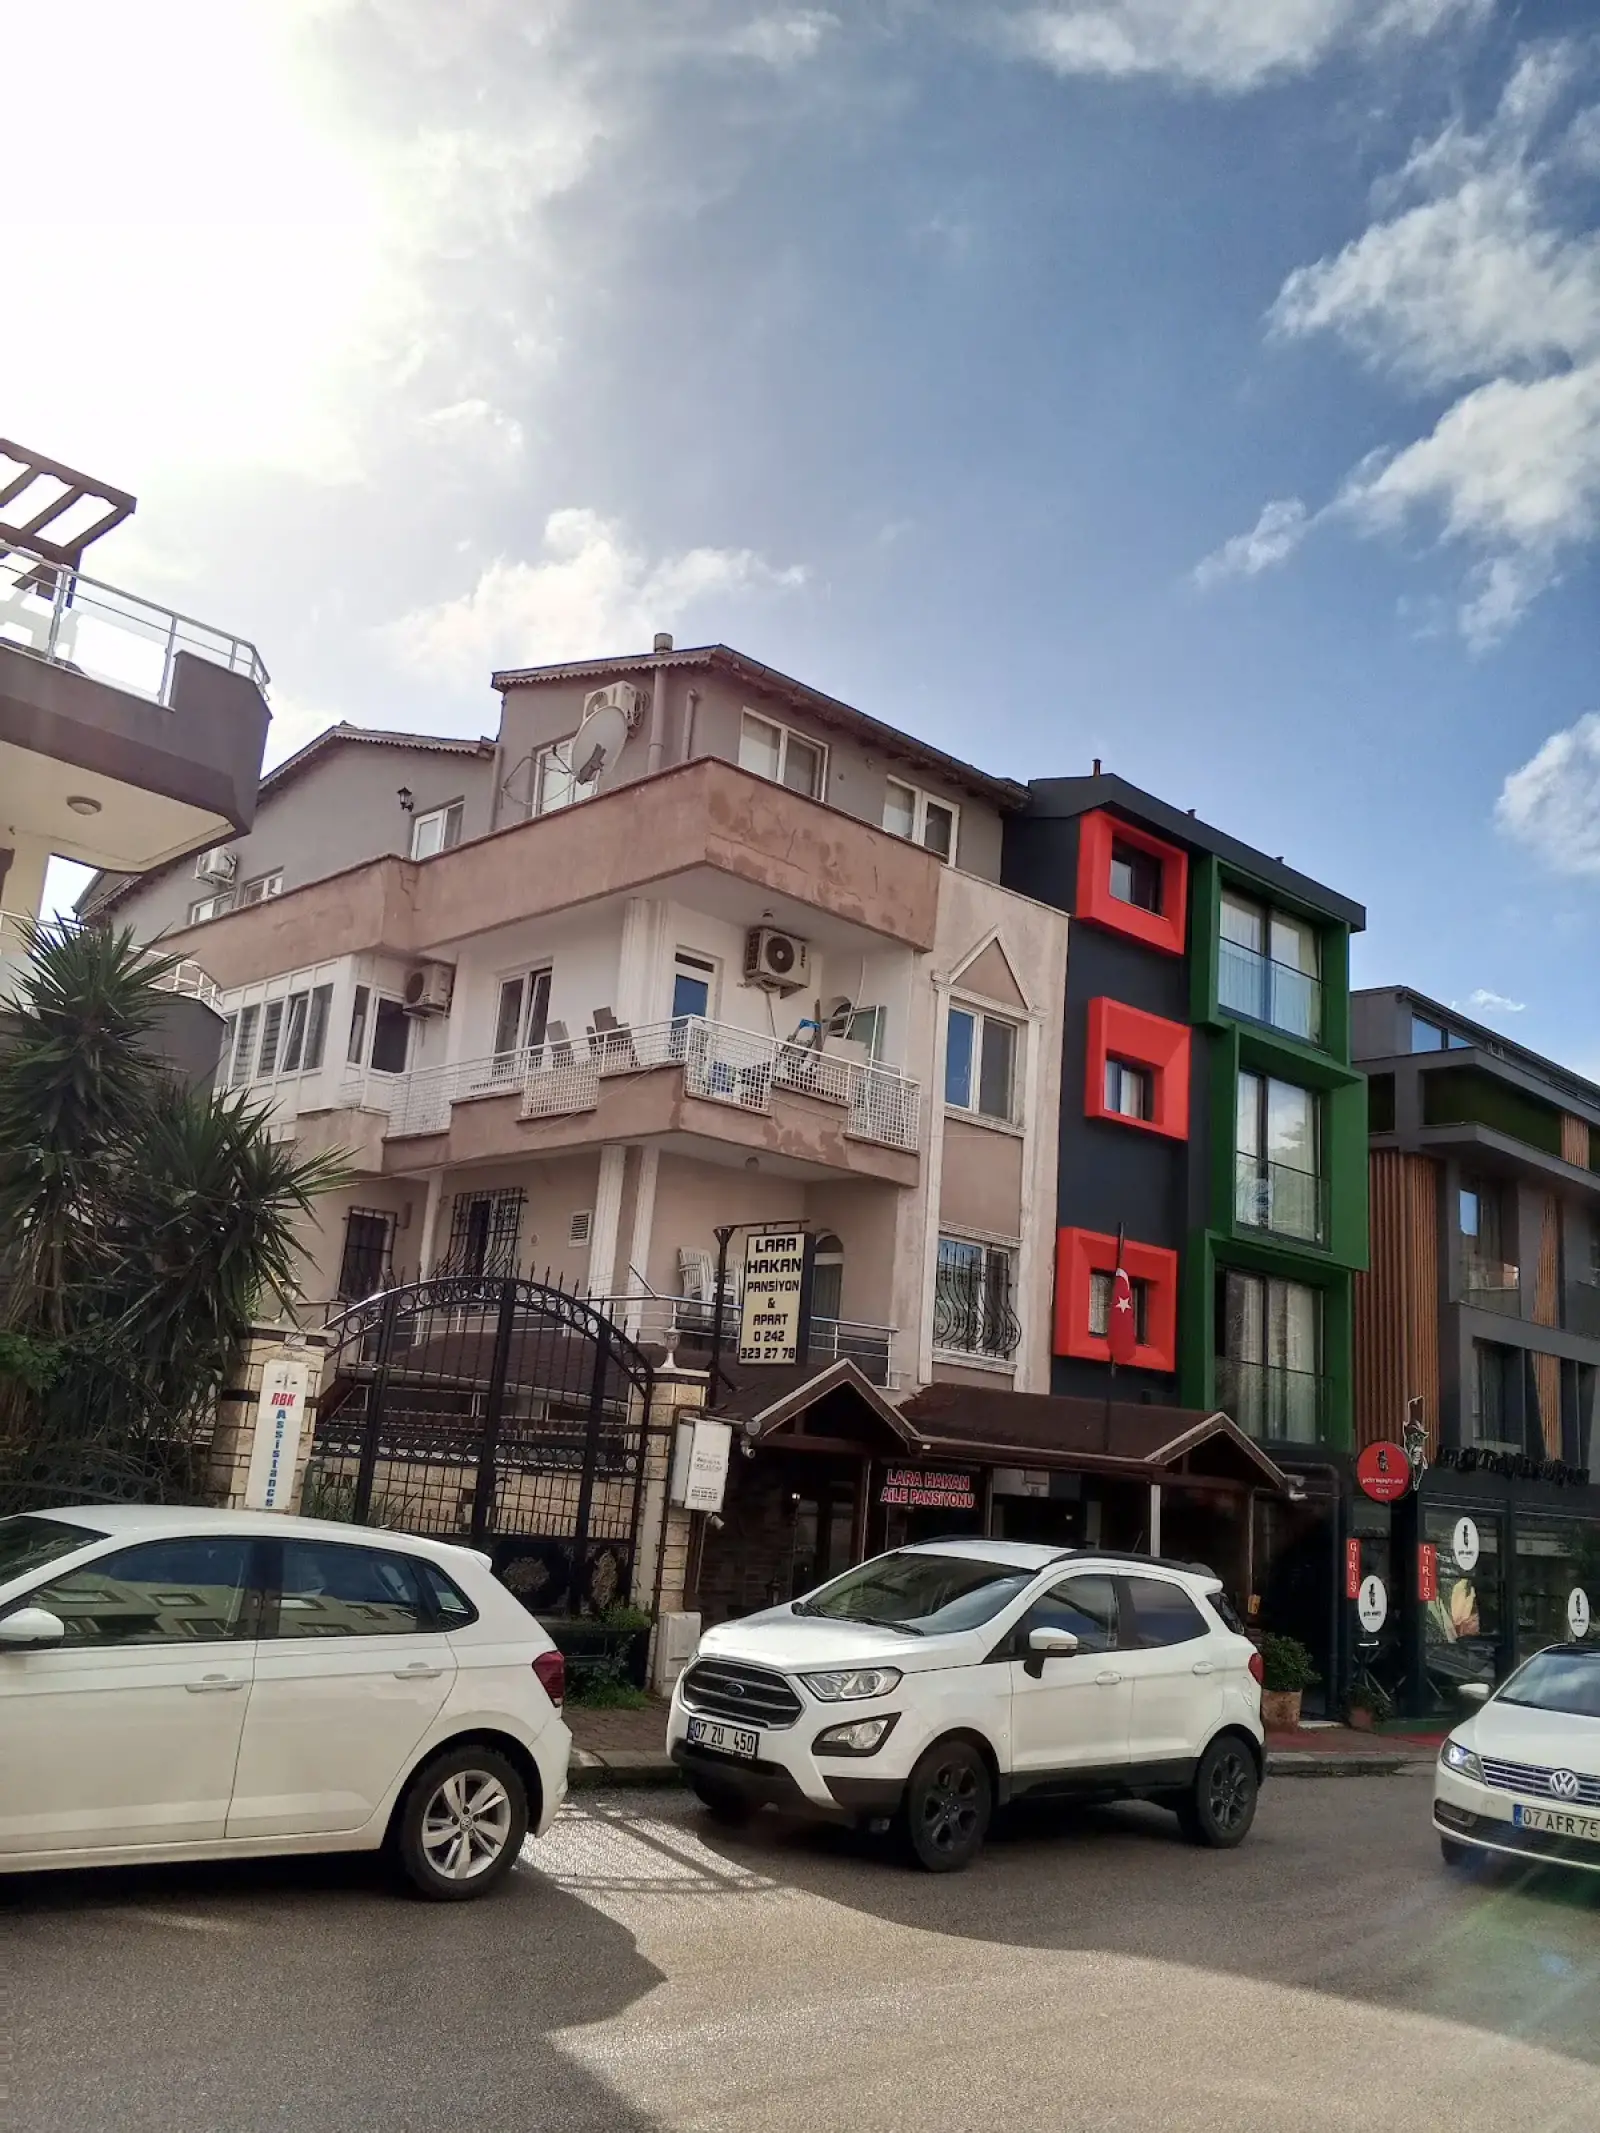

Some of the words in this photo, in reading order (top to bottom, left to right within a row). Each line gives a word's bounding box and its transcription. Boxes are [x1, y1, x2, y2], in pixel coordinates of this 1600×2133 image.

[756, 1238, 796, 1253] LARA
[748, 1258, 801, 1273] HAKAN
[747, 1278, 799, 1293] PANSİYON
[767, 1297, 775, 1308] &
[753, 1313, 788, 1325] APART
[764, 1330, 784, 1342] 242
[740, 1347, 760, 1359] 323
[764, 1347, 777, 1359] 27
[265, 1409, 286, 1507] Assistance
[887, 1469, 922, 1488] LARA
[924, 1472, 970, 1491] HAKAN
[695, 1721, 707, 1739] 07
[711, 1726, 725, 1745] ZU
[734, 1731, 754, 1753] 450
[1524, 1809, 1541, 1826] 07
[1546, 1813, 1575, 1834] AFR
[1579, 1819, 1598, 1838] 75
